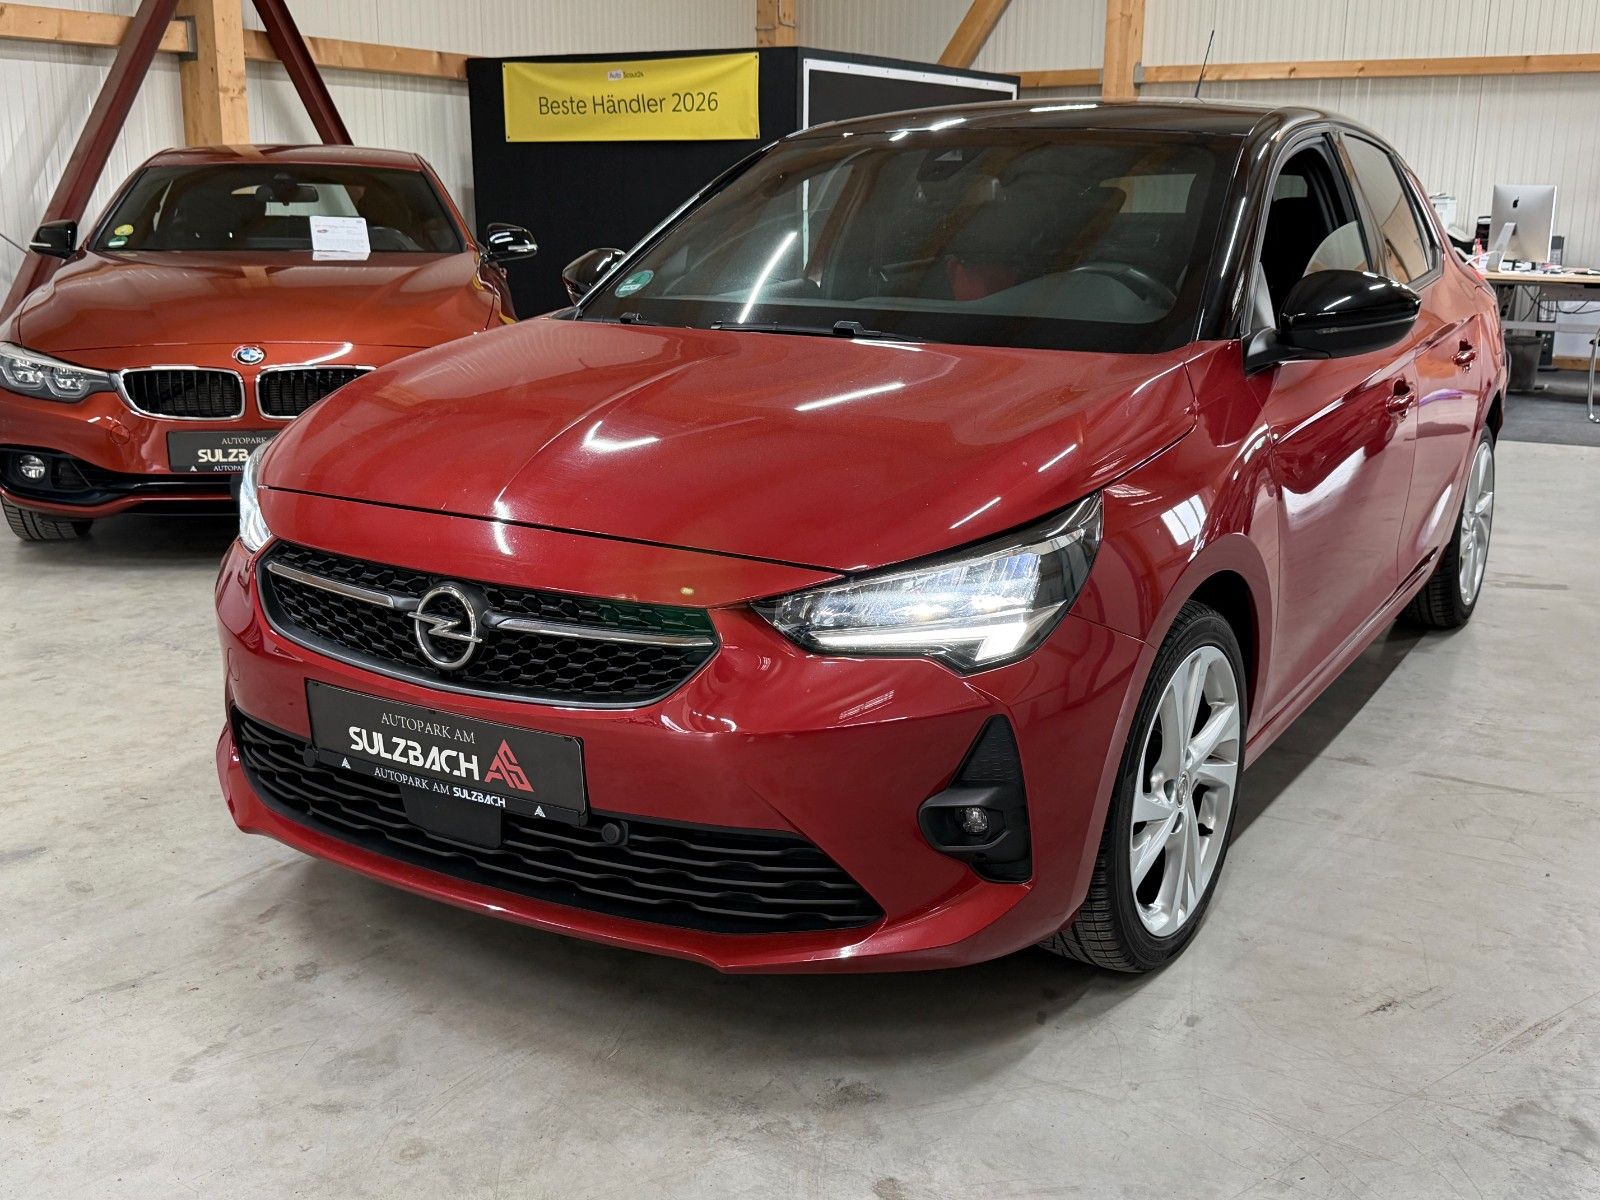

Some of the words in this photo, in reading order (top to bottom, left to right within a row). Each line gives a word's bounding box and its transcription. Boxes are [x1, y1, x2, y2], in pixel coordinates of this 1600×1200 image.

[538, 96, 587, 116] Beste
[592, 93, 666, 115] Händler
[671, 91, 718, 113] 2026
[197, 448, 249, 463] SULZB
[381, 712, 451, 739] AUTOPARK
[453, 728, 476, 744] AM
[348, 726, 480, 780] SULZBACH
[374, 766, 430, 790] AUTOPARK
[432, 782, 451, 796] AM
[452, 786, 506, 808] SULZBACH
